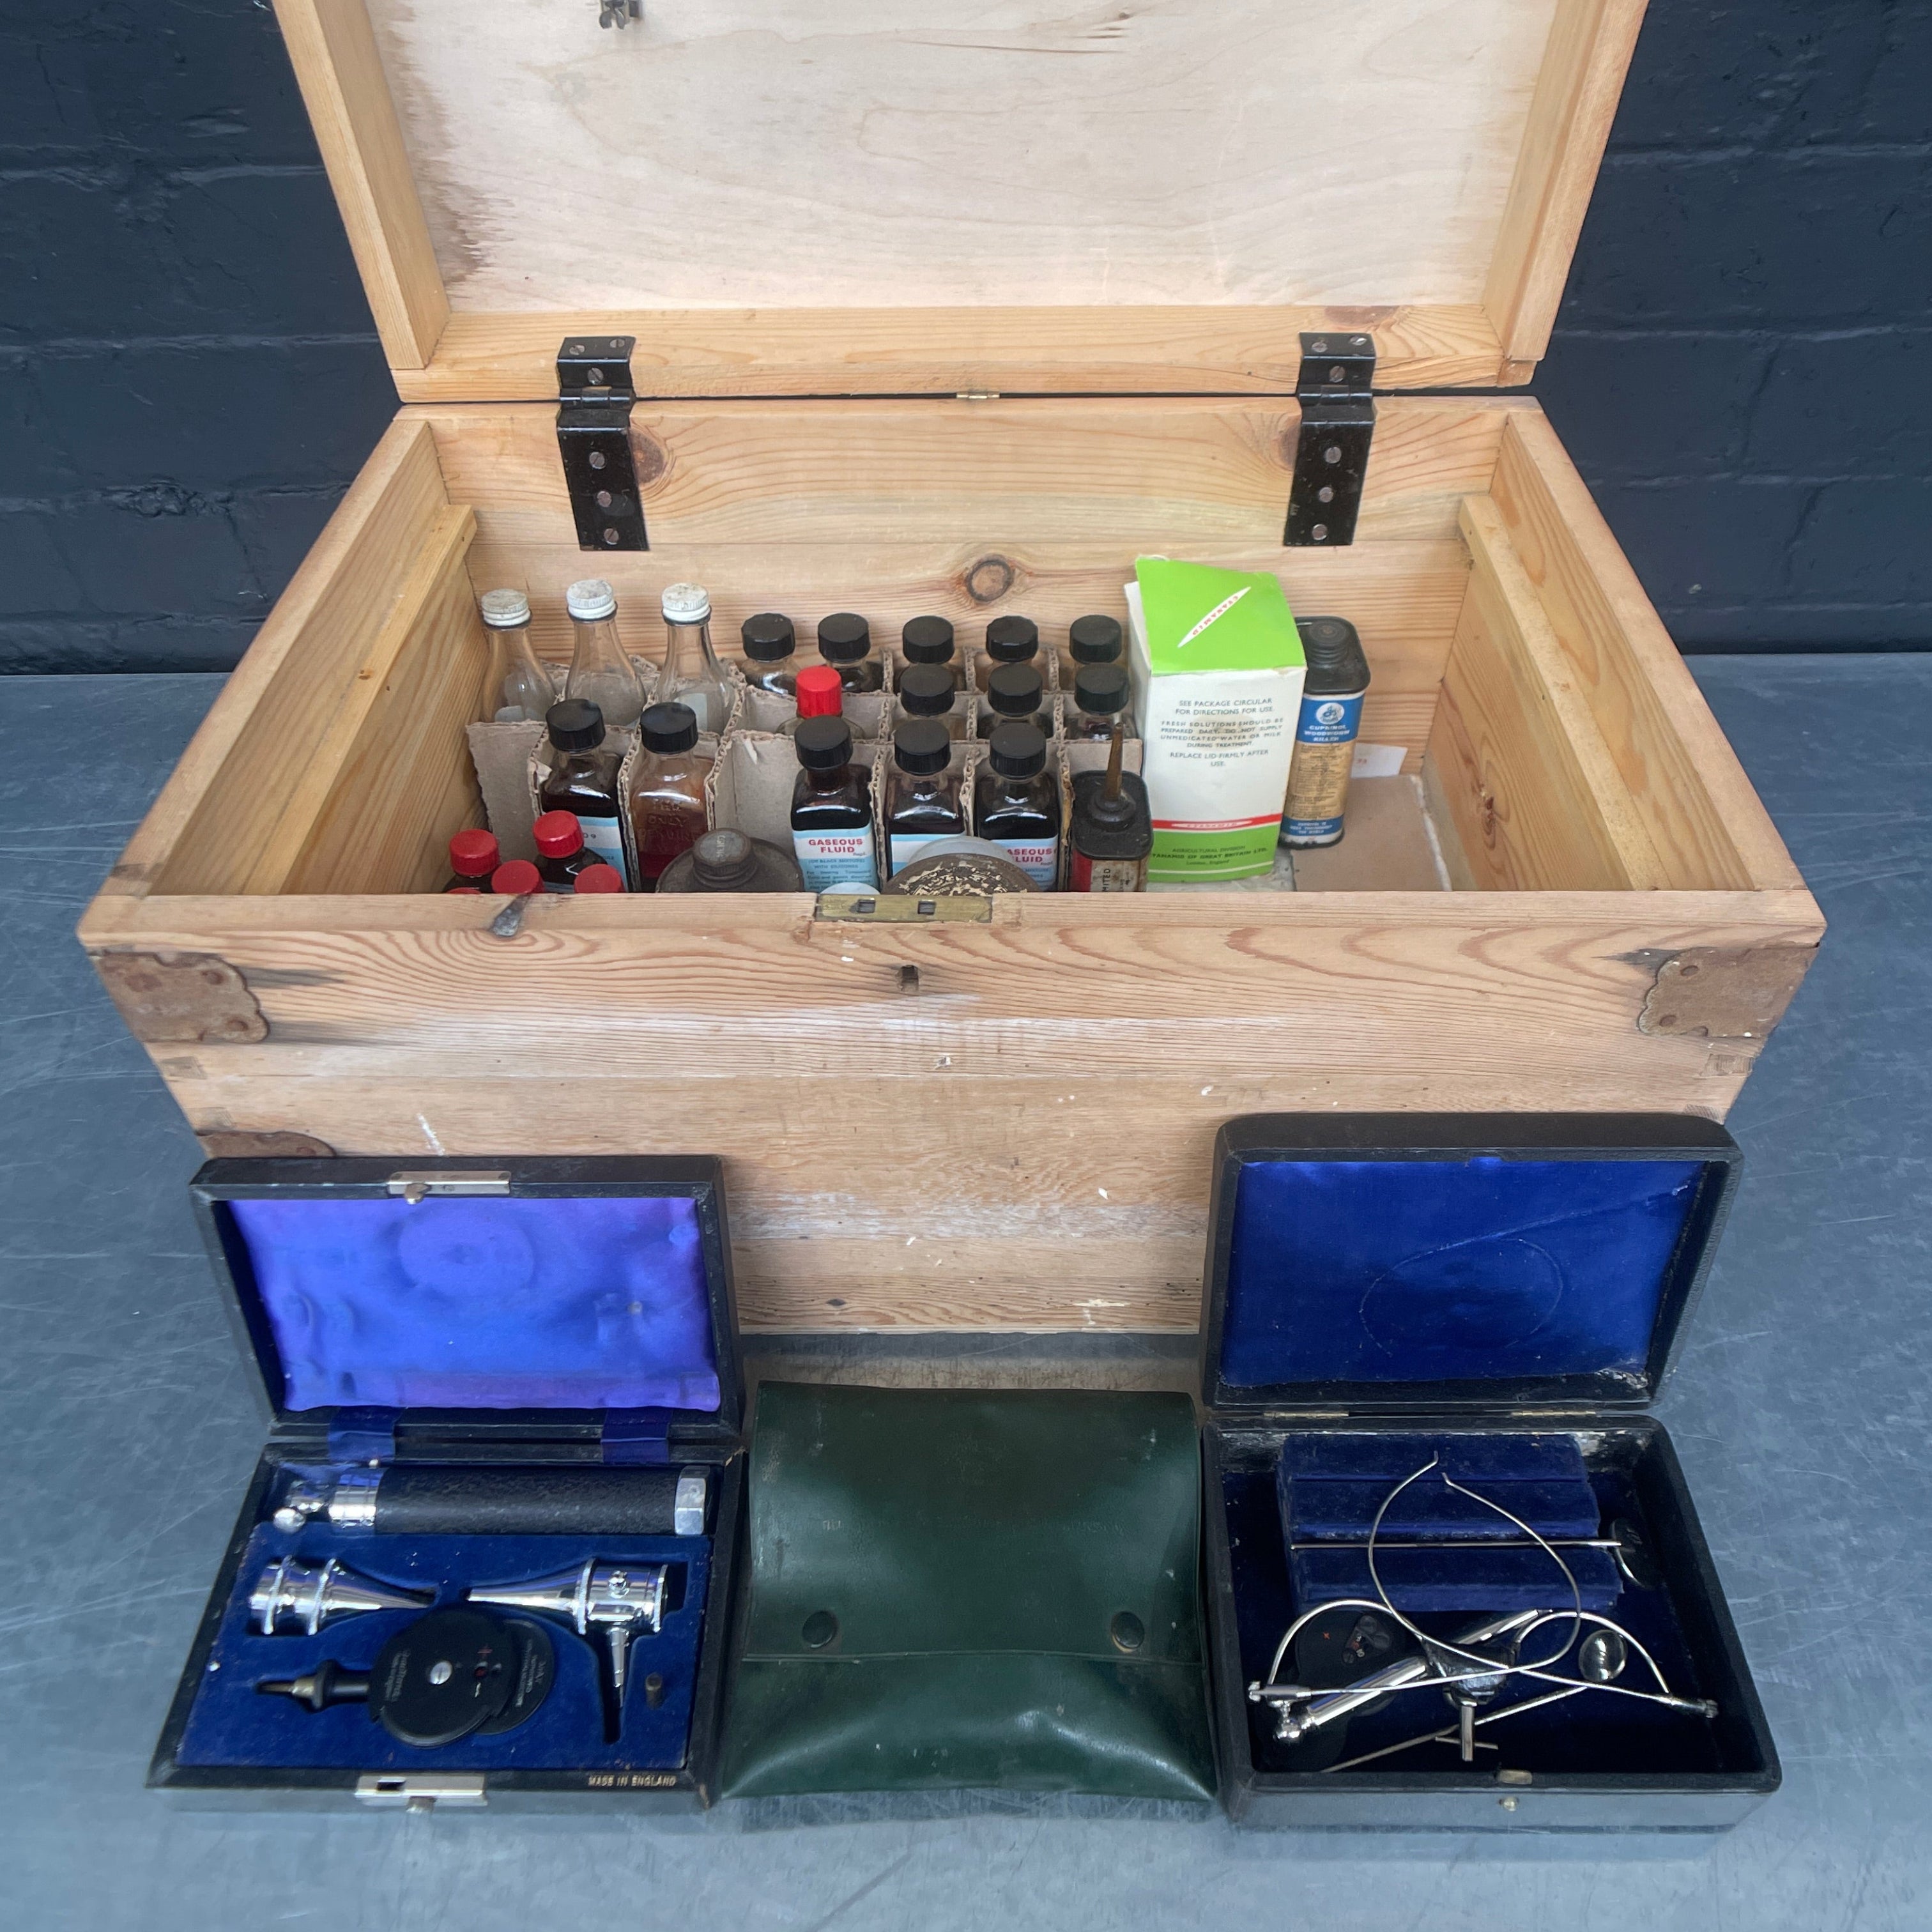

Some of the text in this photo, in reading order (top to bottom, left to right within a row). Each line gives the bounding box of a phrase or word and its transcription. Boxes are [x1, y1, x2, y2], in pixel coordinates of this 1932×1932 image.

[1234, 698, 1273, 706] CIRCULAR
[1238, 719, 1271, 727] SHOULD
[1102, 868, 1110, 892] MITED
[588, 1775, 677, 1787] MADE IN ENGLAND
